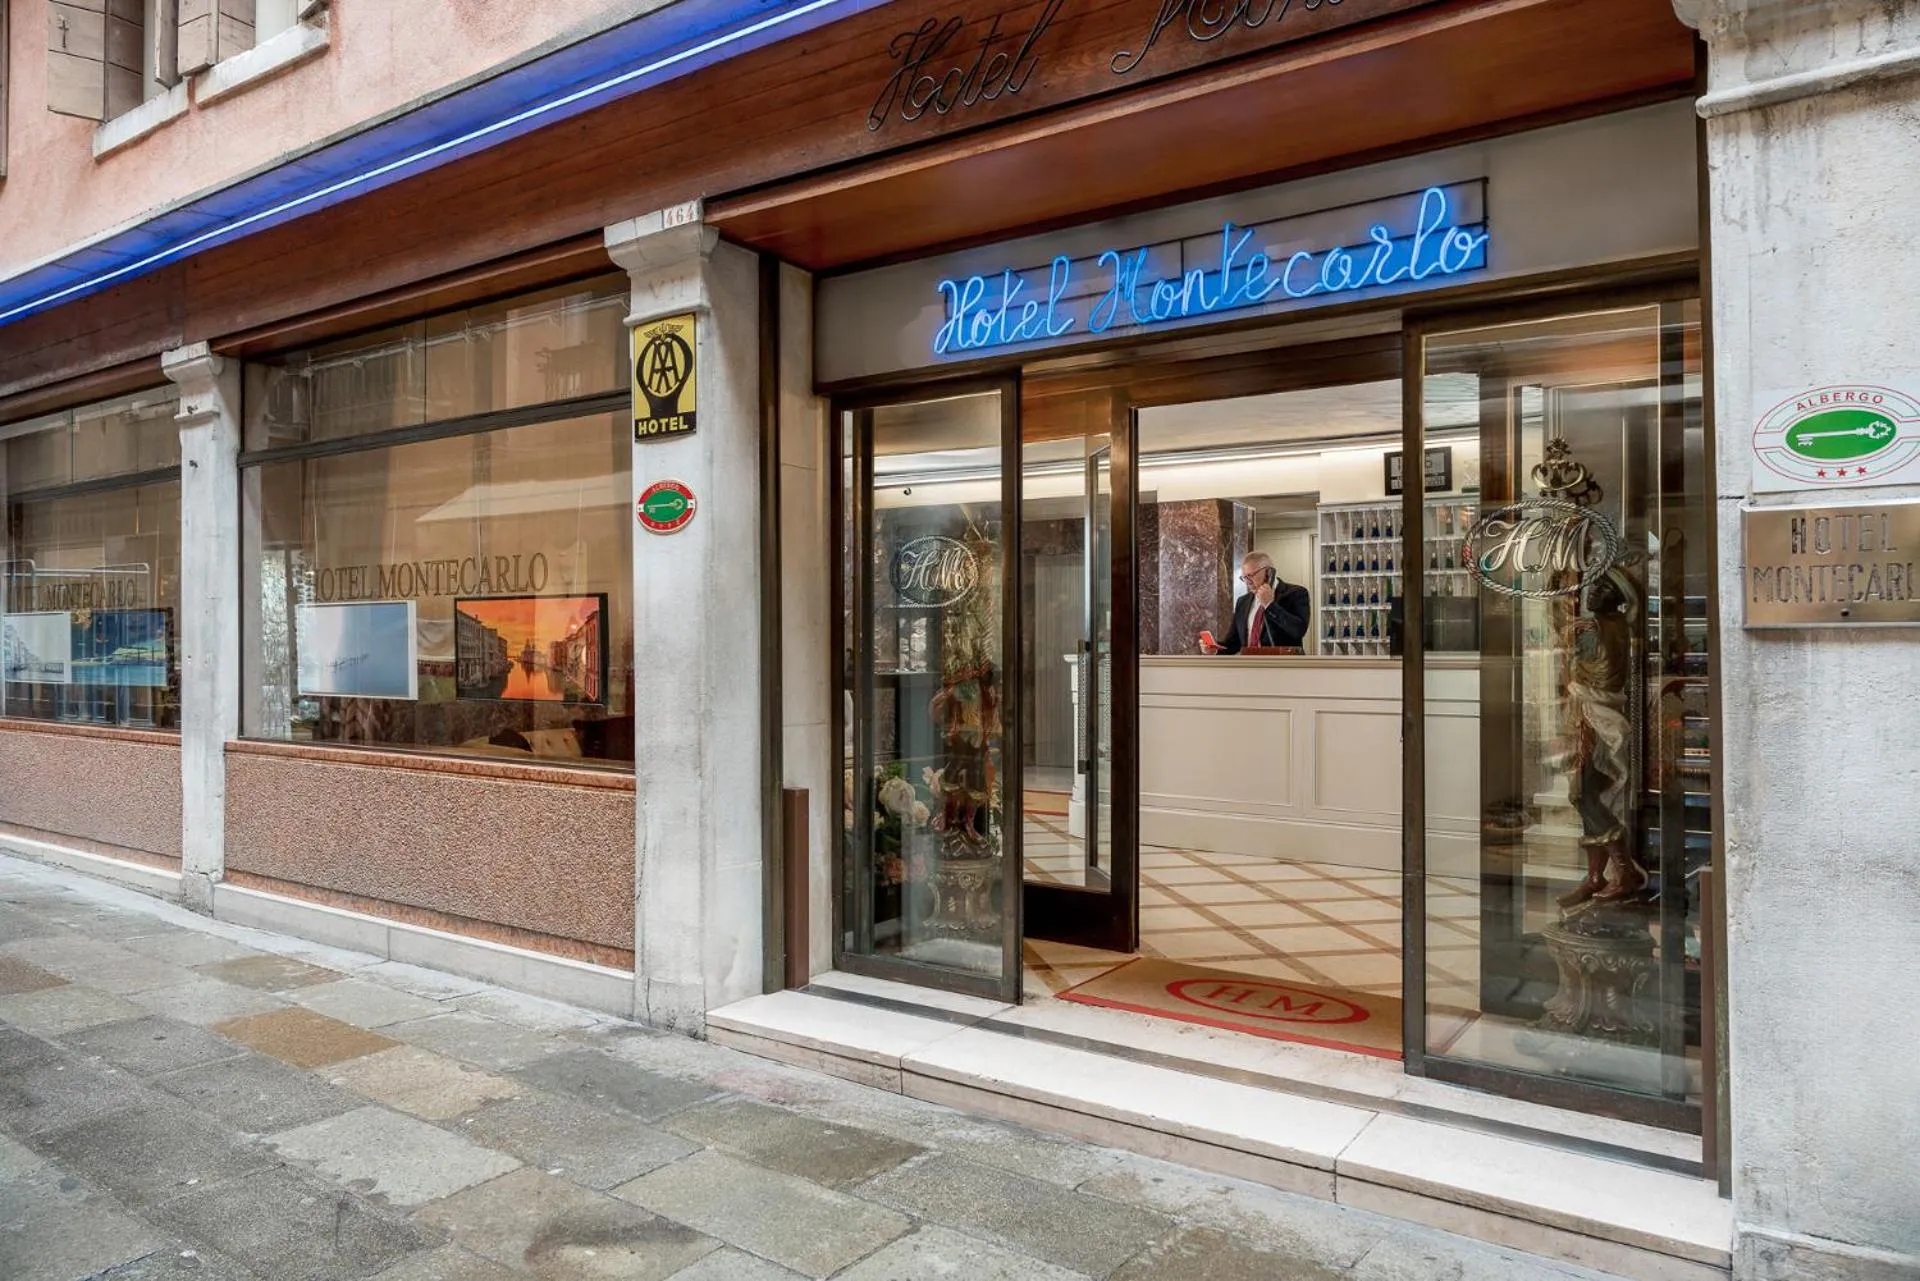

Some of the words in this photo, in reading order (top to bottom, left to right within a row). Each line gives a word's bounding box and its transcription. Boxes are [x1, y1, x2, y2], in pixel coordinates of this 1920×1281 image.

[867, 0, 1063, 132] Hotel
[933, 255, 1074, 354] Hotel
[1087, 187, 1489, 333] Montecarlo
[1796, 392, 1884, 411] ALBERGO
[638, 416, 689, 436] HOTEL
[1791, 513, 1898, 555] HOTEL
[376, 552, 549, 599] MONTECARLO
[1205, 985, 1326, 1018] HM
